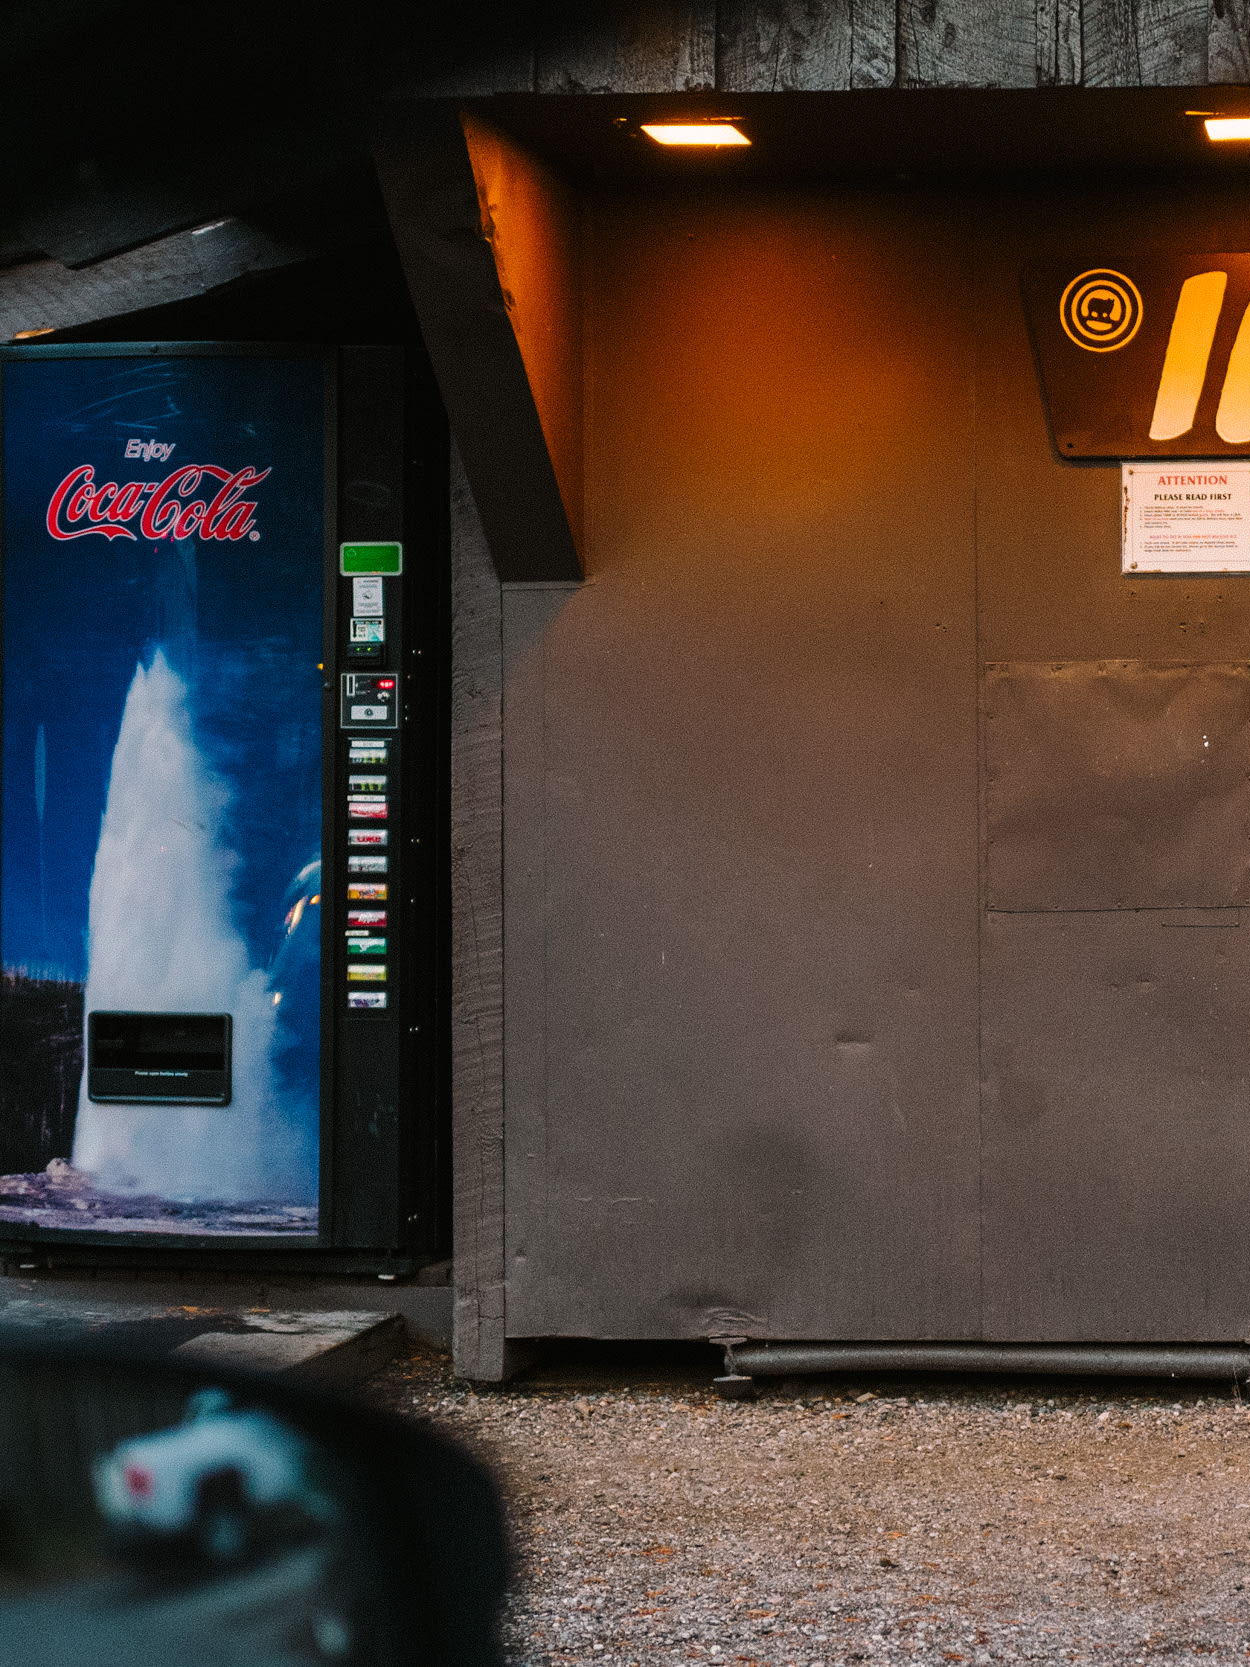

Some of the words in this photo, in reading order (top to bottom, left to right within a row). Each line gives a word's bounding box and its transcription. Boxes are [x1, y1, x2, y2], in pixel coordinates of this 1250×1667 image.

[125, 439, 175, 461] Enjoy
[1157, 475, 1228, 486] ATTENTION
[47, 464, 272, 540] Coca-Cola
[1154, 493, 1182, 501] PLEASE
[1185, 493, 1208, 501] READ
